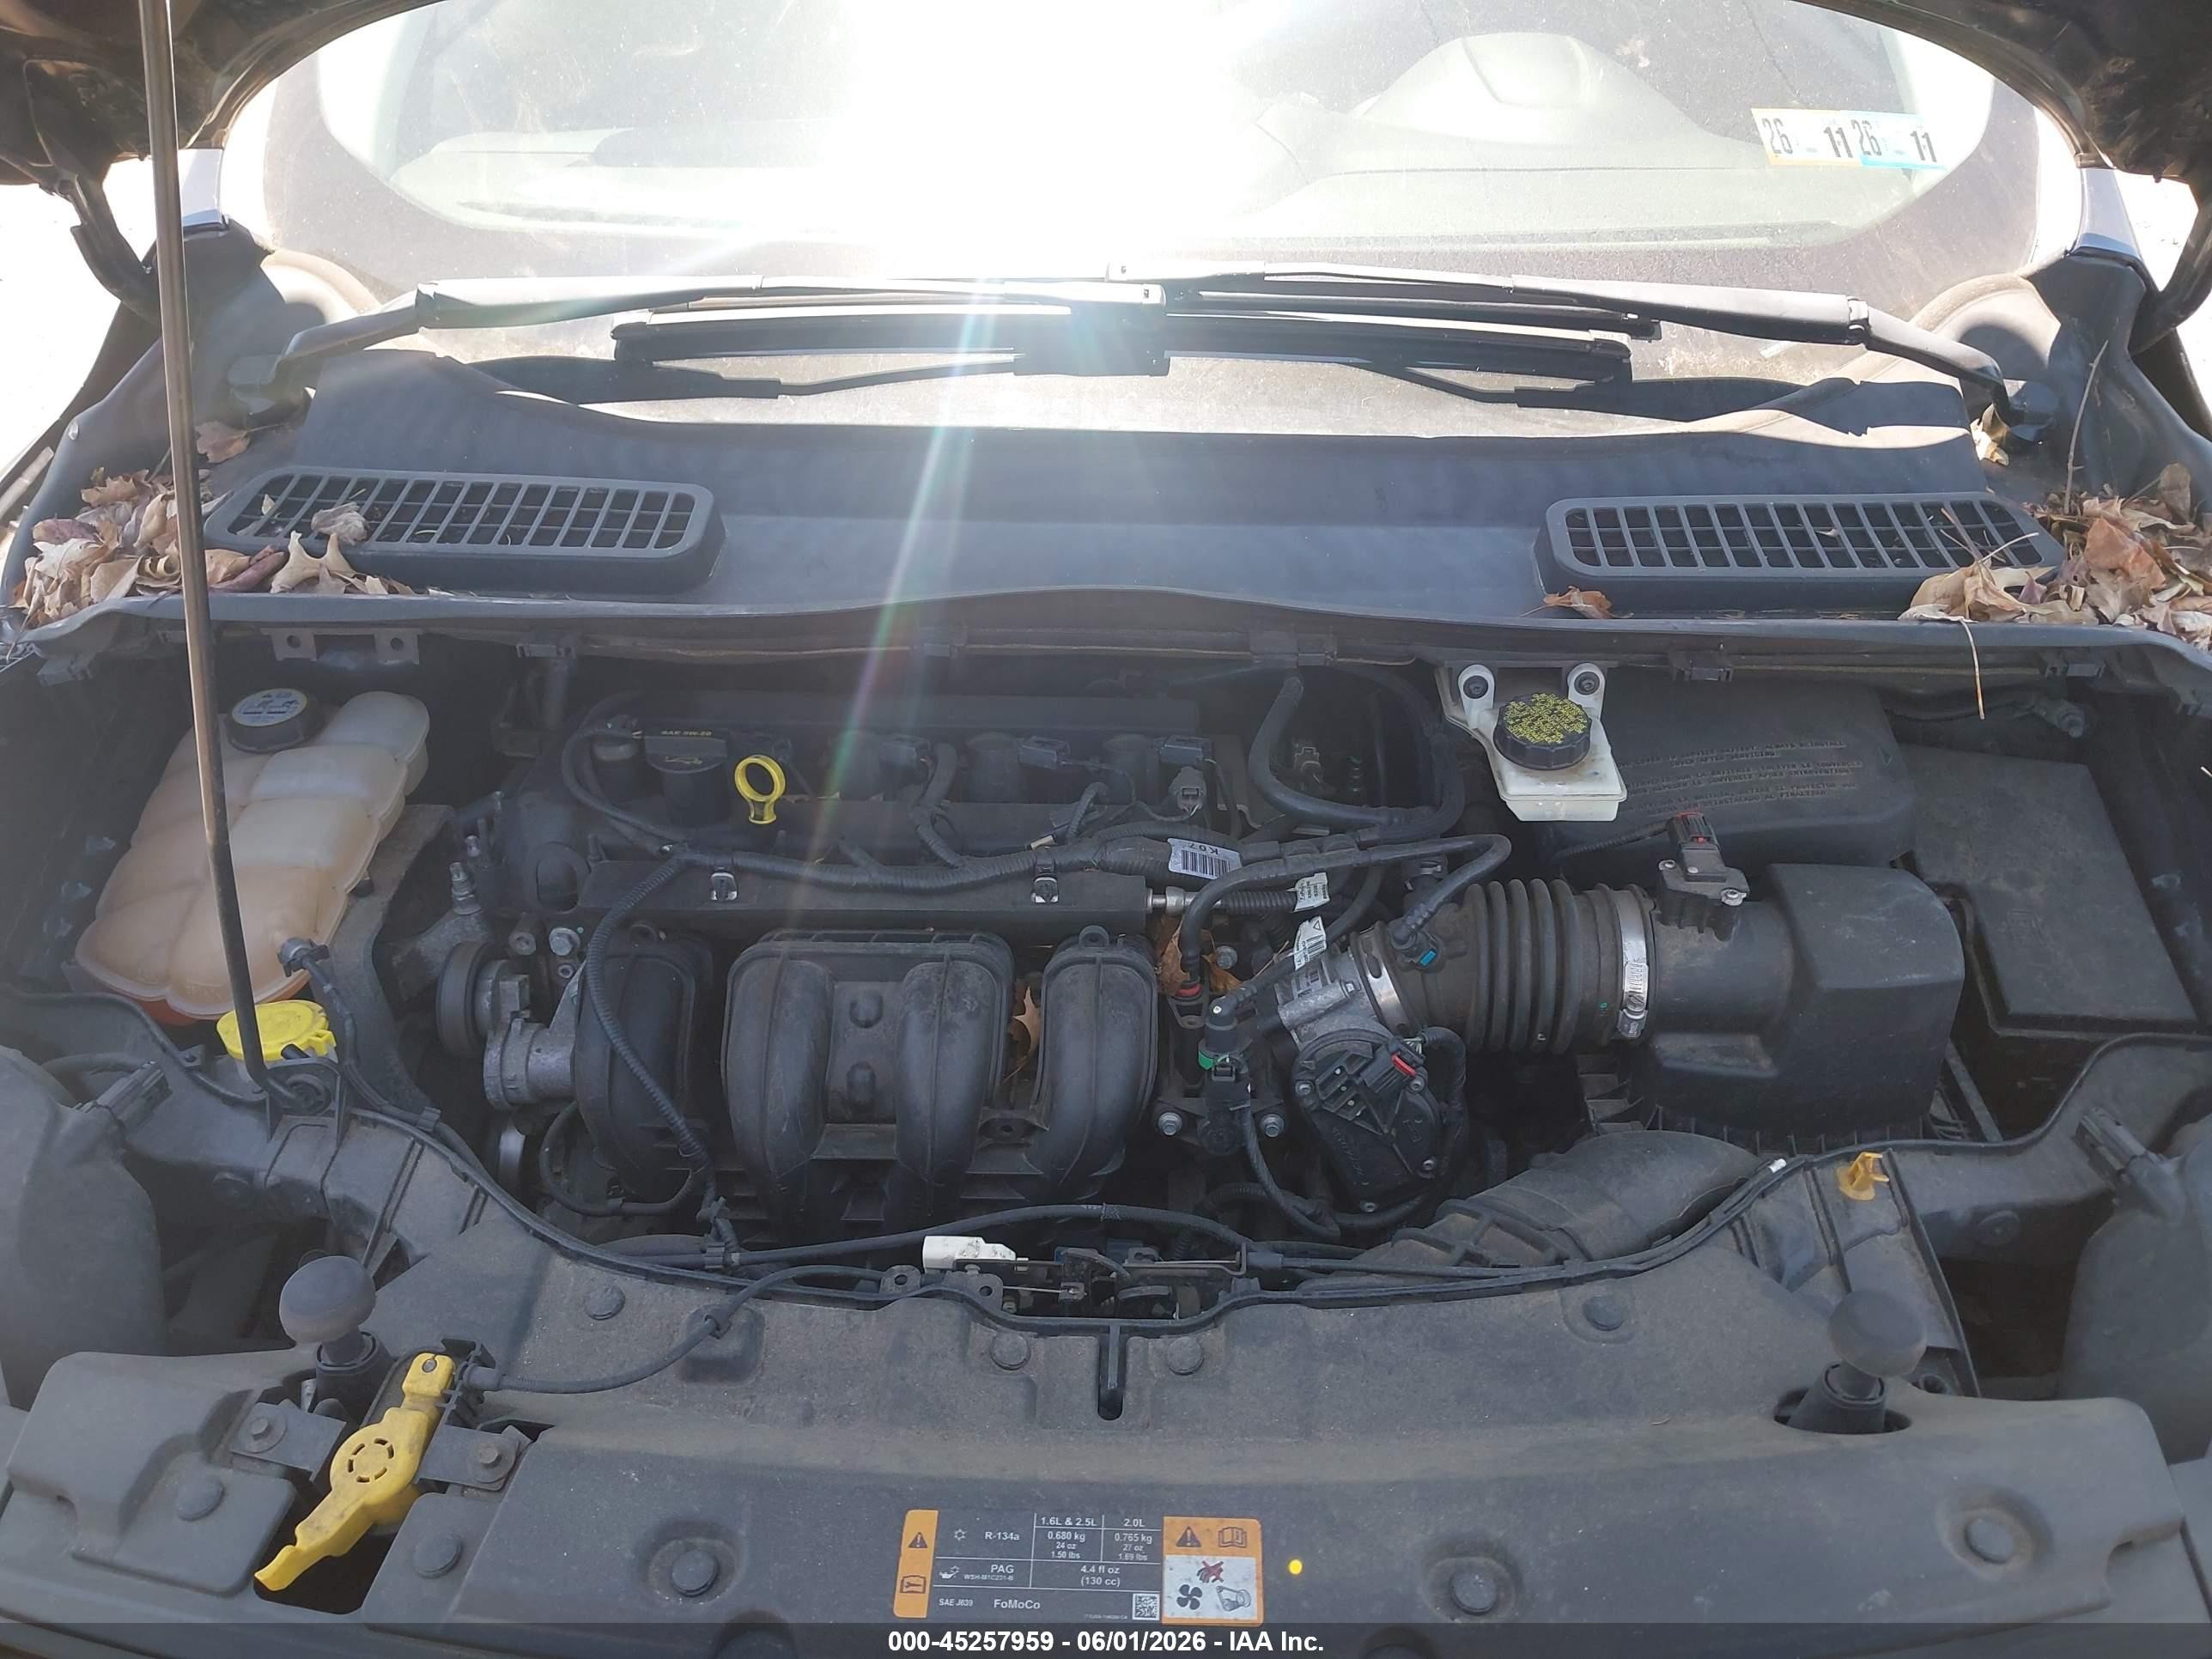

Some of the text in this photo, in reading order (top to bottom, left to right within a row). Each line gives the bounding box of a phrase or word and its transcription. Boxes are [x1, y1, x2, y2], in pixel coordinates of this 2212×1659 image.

[1761, 117, 1793, 155] 26
[1850, 118, 1882, 156] 26
[1041, 1516, 1097, 1527] 1.6L & 2.5L
[1123, 1518, 1146, 1528] 2.0L
[985, 1531, 1020, 1540] R-134a
[1048, 1531, 1085, 1542] 0.680 kg
[1114, 1532, 1152, 1545] 0.765 kg
[1122, 1543, 1133, 1552] 27
[990, 1564, 1014, 1573] PAG
[1080, 1565, 1096, 1573] 4.4
[1098, 1565, 1105, 1573] fl
[1080, 1576, 1121, 1588] (130 cc)
[994, 1599, 1041, 1609] FoMoCo
